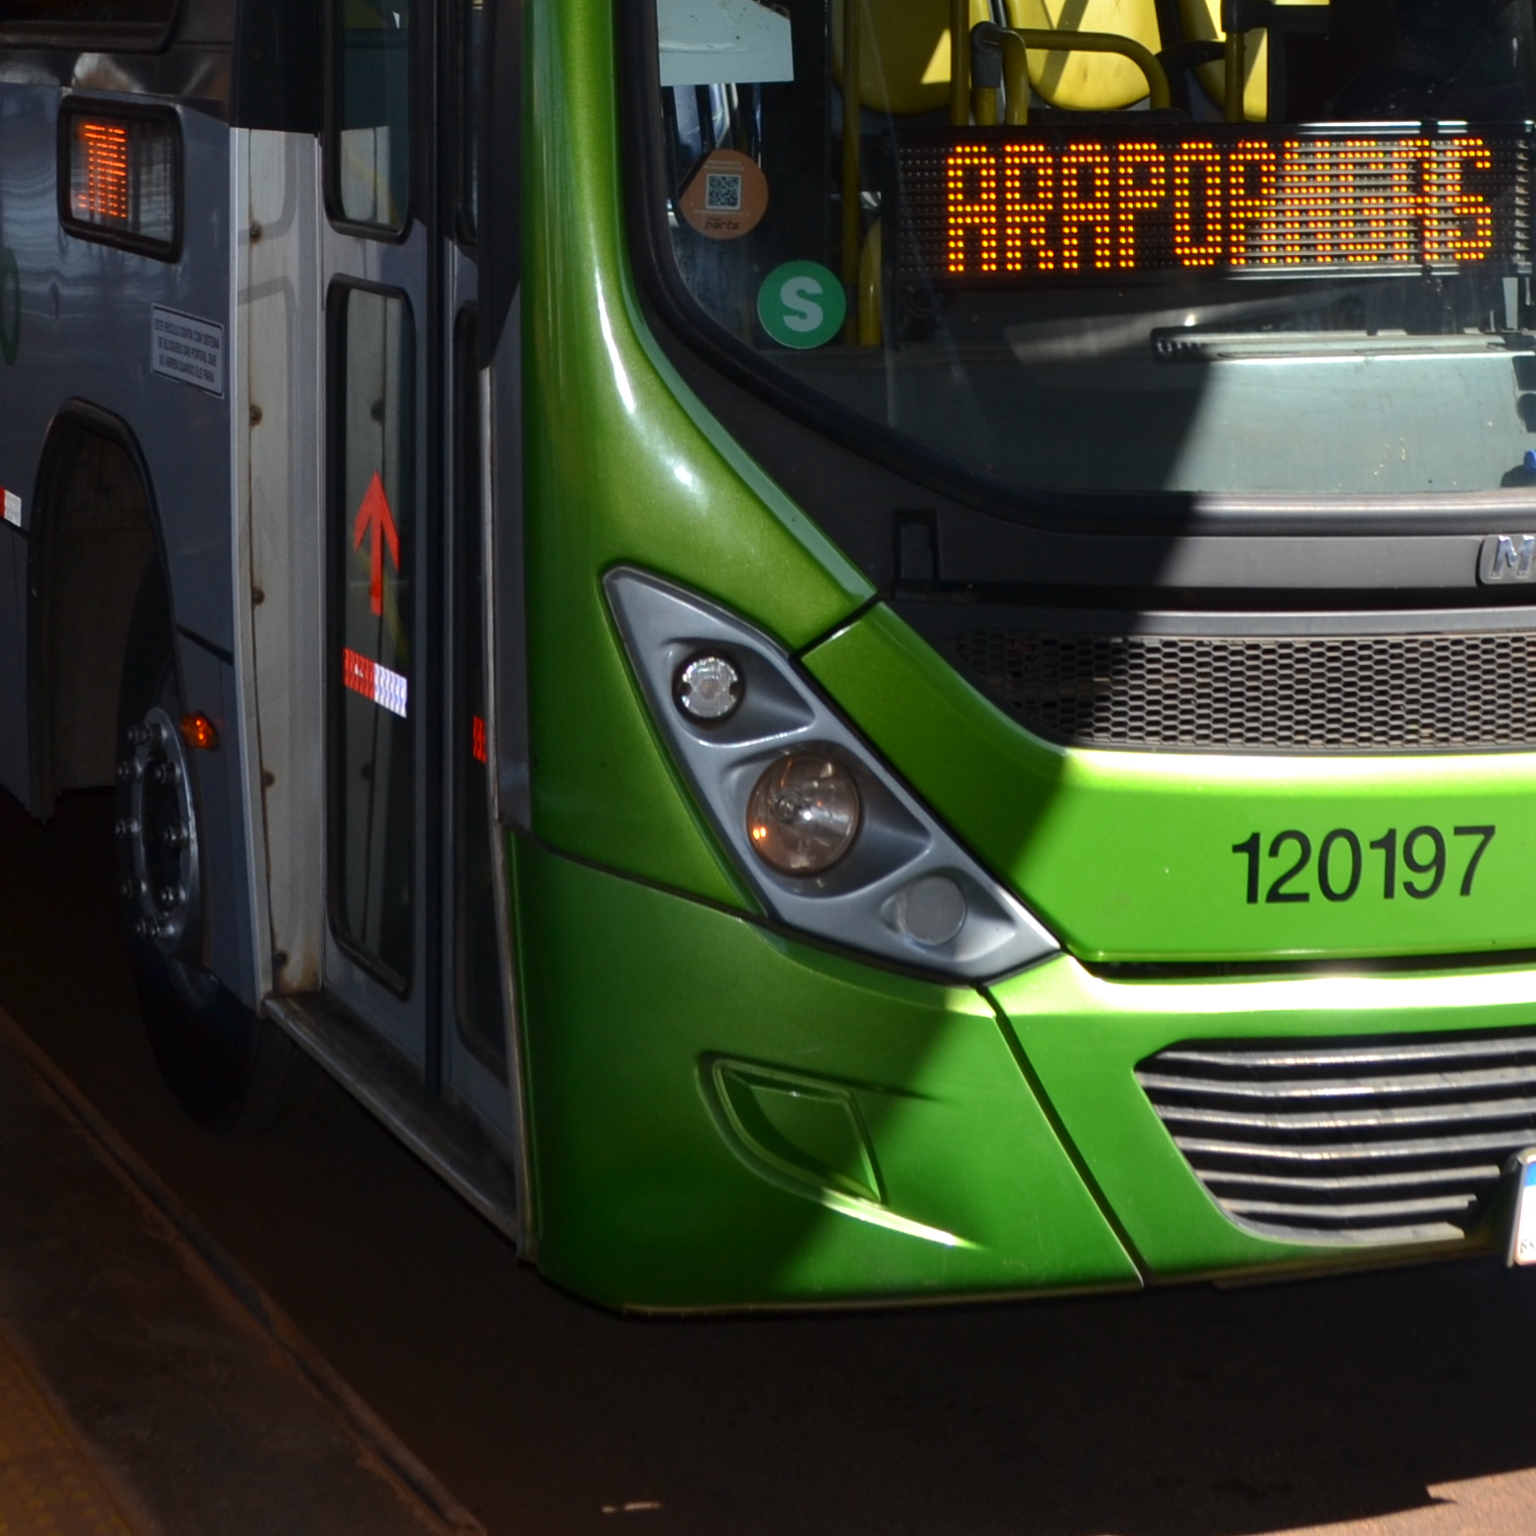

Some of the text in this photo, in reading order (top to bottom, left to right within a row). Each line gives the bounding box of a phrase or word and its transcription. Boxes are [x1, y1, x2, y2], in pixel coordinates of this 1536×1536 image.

[704, 220, 740, 231] parts
[947, 138, 1492, 272] ARAPOANGAS
[780, 276, 824, 333] S
[1230, 824, 1496, 905] 120197
